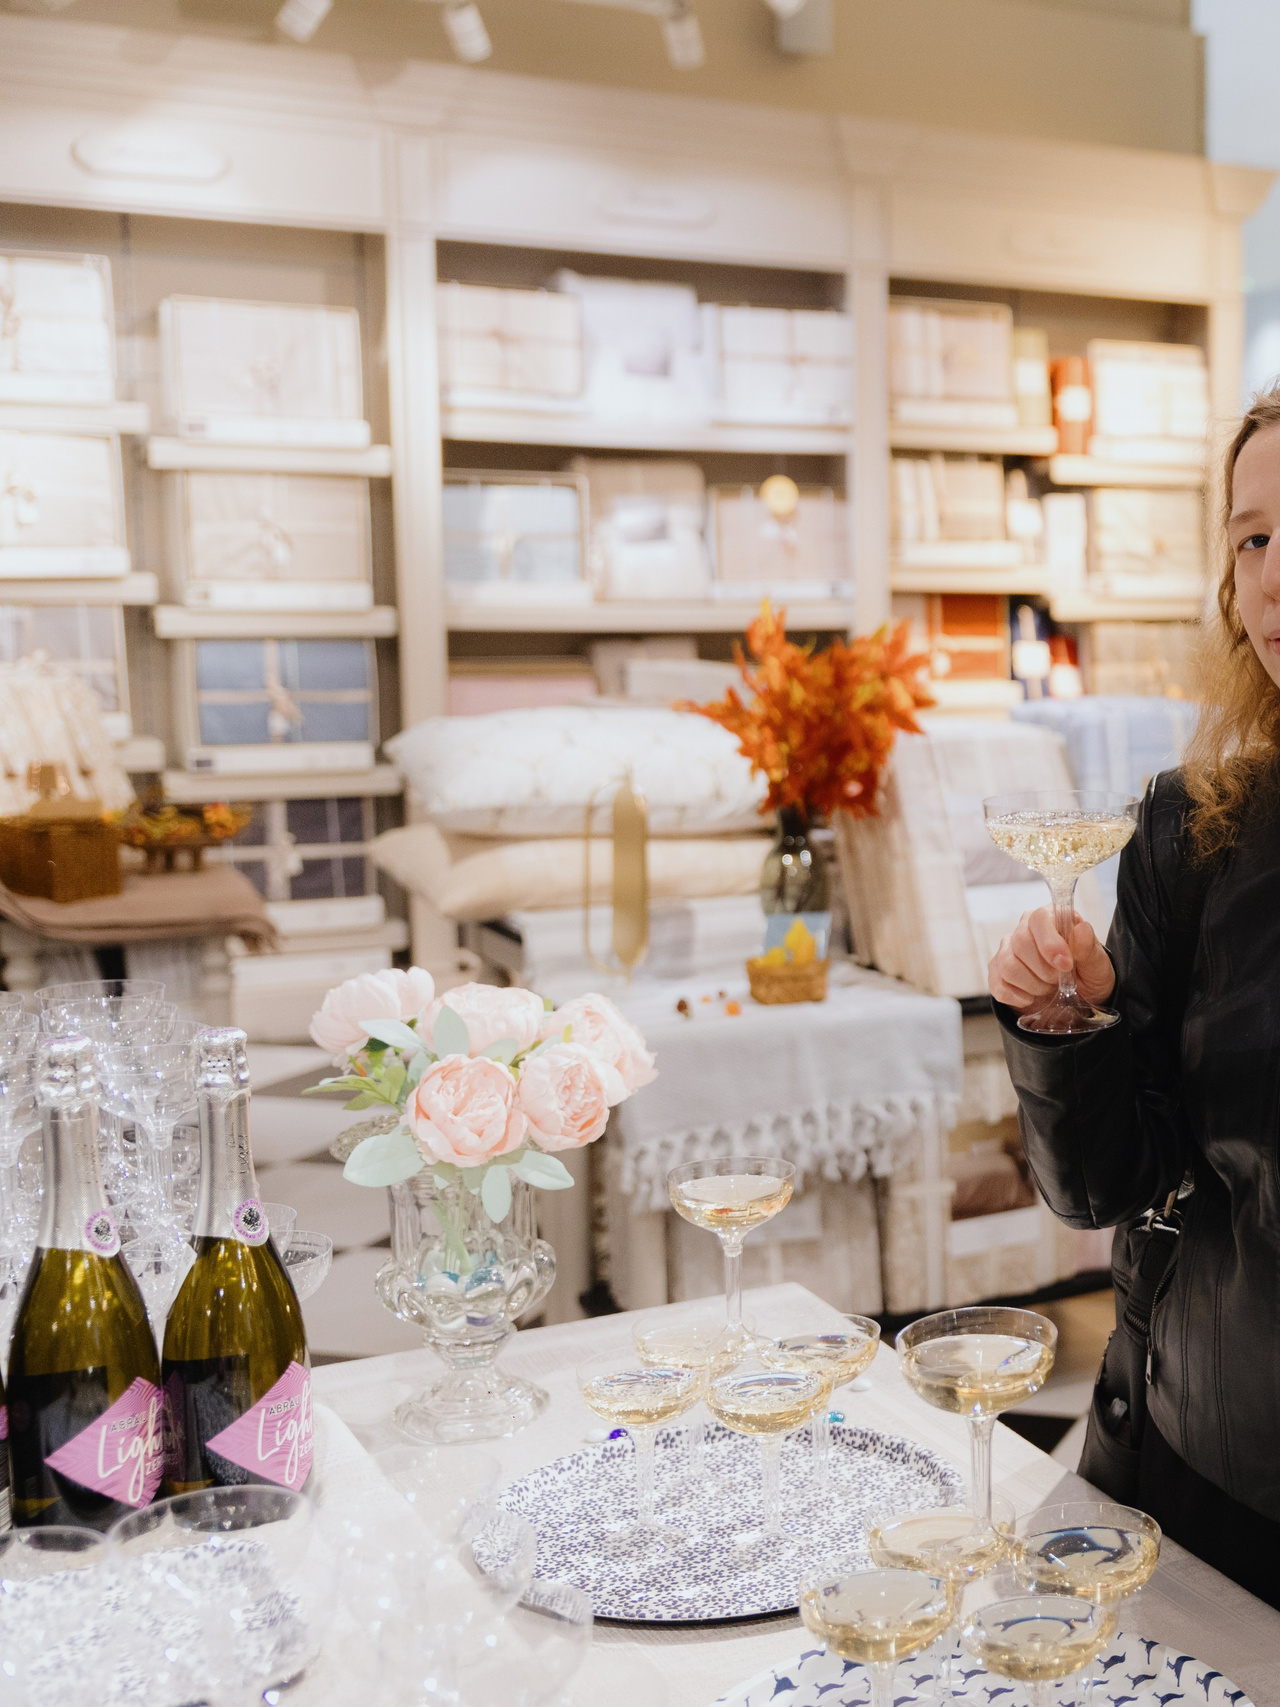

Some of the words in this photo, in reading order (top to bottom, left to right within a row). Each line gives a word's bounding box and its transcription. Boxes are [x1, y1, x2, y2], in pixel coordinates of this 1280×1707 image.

[267, 1394, 301, 1416] ABRAU
[110, 1410, 148, 1434] ABRAU
[97, 1396, 162, 1504] Ligh
[299, 1438, 314, 1458] ZER
[145, 1452, 165, 1476] ZER
